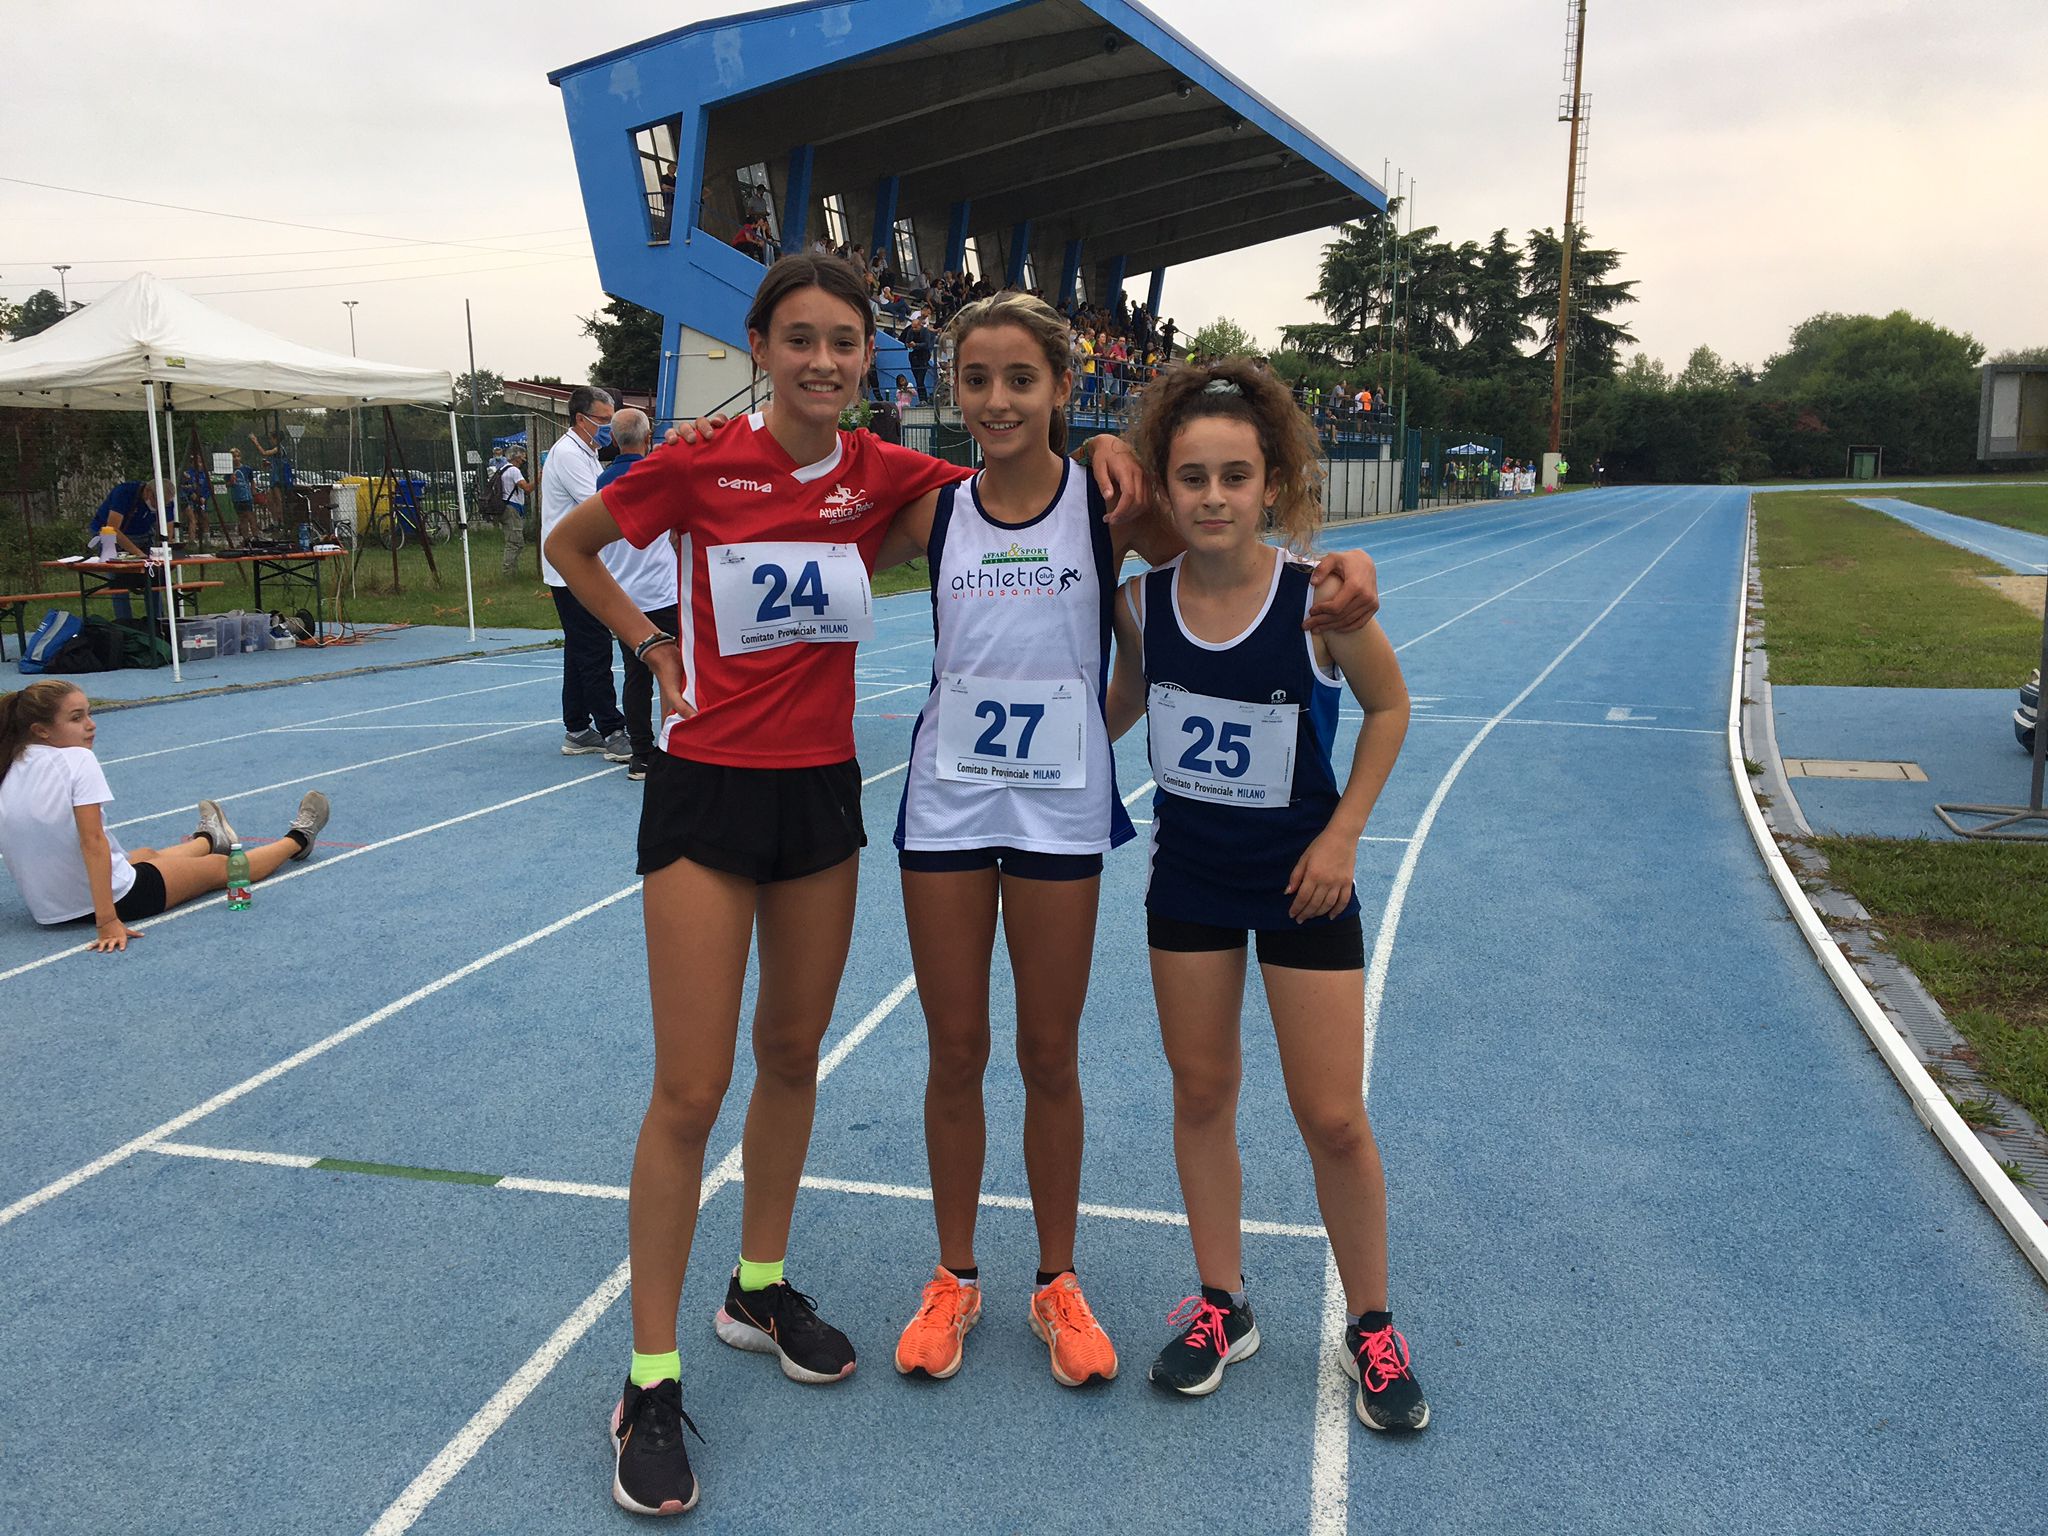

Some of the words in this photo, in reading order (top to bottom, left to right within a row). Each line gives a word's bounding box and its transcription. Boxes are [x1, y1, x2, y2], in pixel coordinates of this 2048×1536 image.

[819, 506, 853, 519] Atletica
[982, 551, 1008, 560] AFFARI
[752, 561, 829, 622] 24
[741, 633, 774, 644] Comitato
[778, 626, 817, 638] Provinciale
[820, 624, 849, 634] MILANO
[974, 700, 1044, 758] 27
[1178, 716, 1251, 778] 25
[957, 762, 988, 775] Comitato
[991, 766, 1029, 779] Provinciale
[1033, 770, 1061, 780] MILANO
[1163, 773, 1191, 789] Comitato
[1194, 782, 1233, 797] Provinciale
[1237, 789, 1266, 799] MILANO
